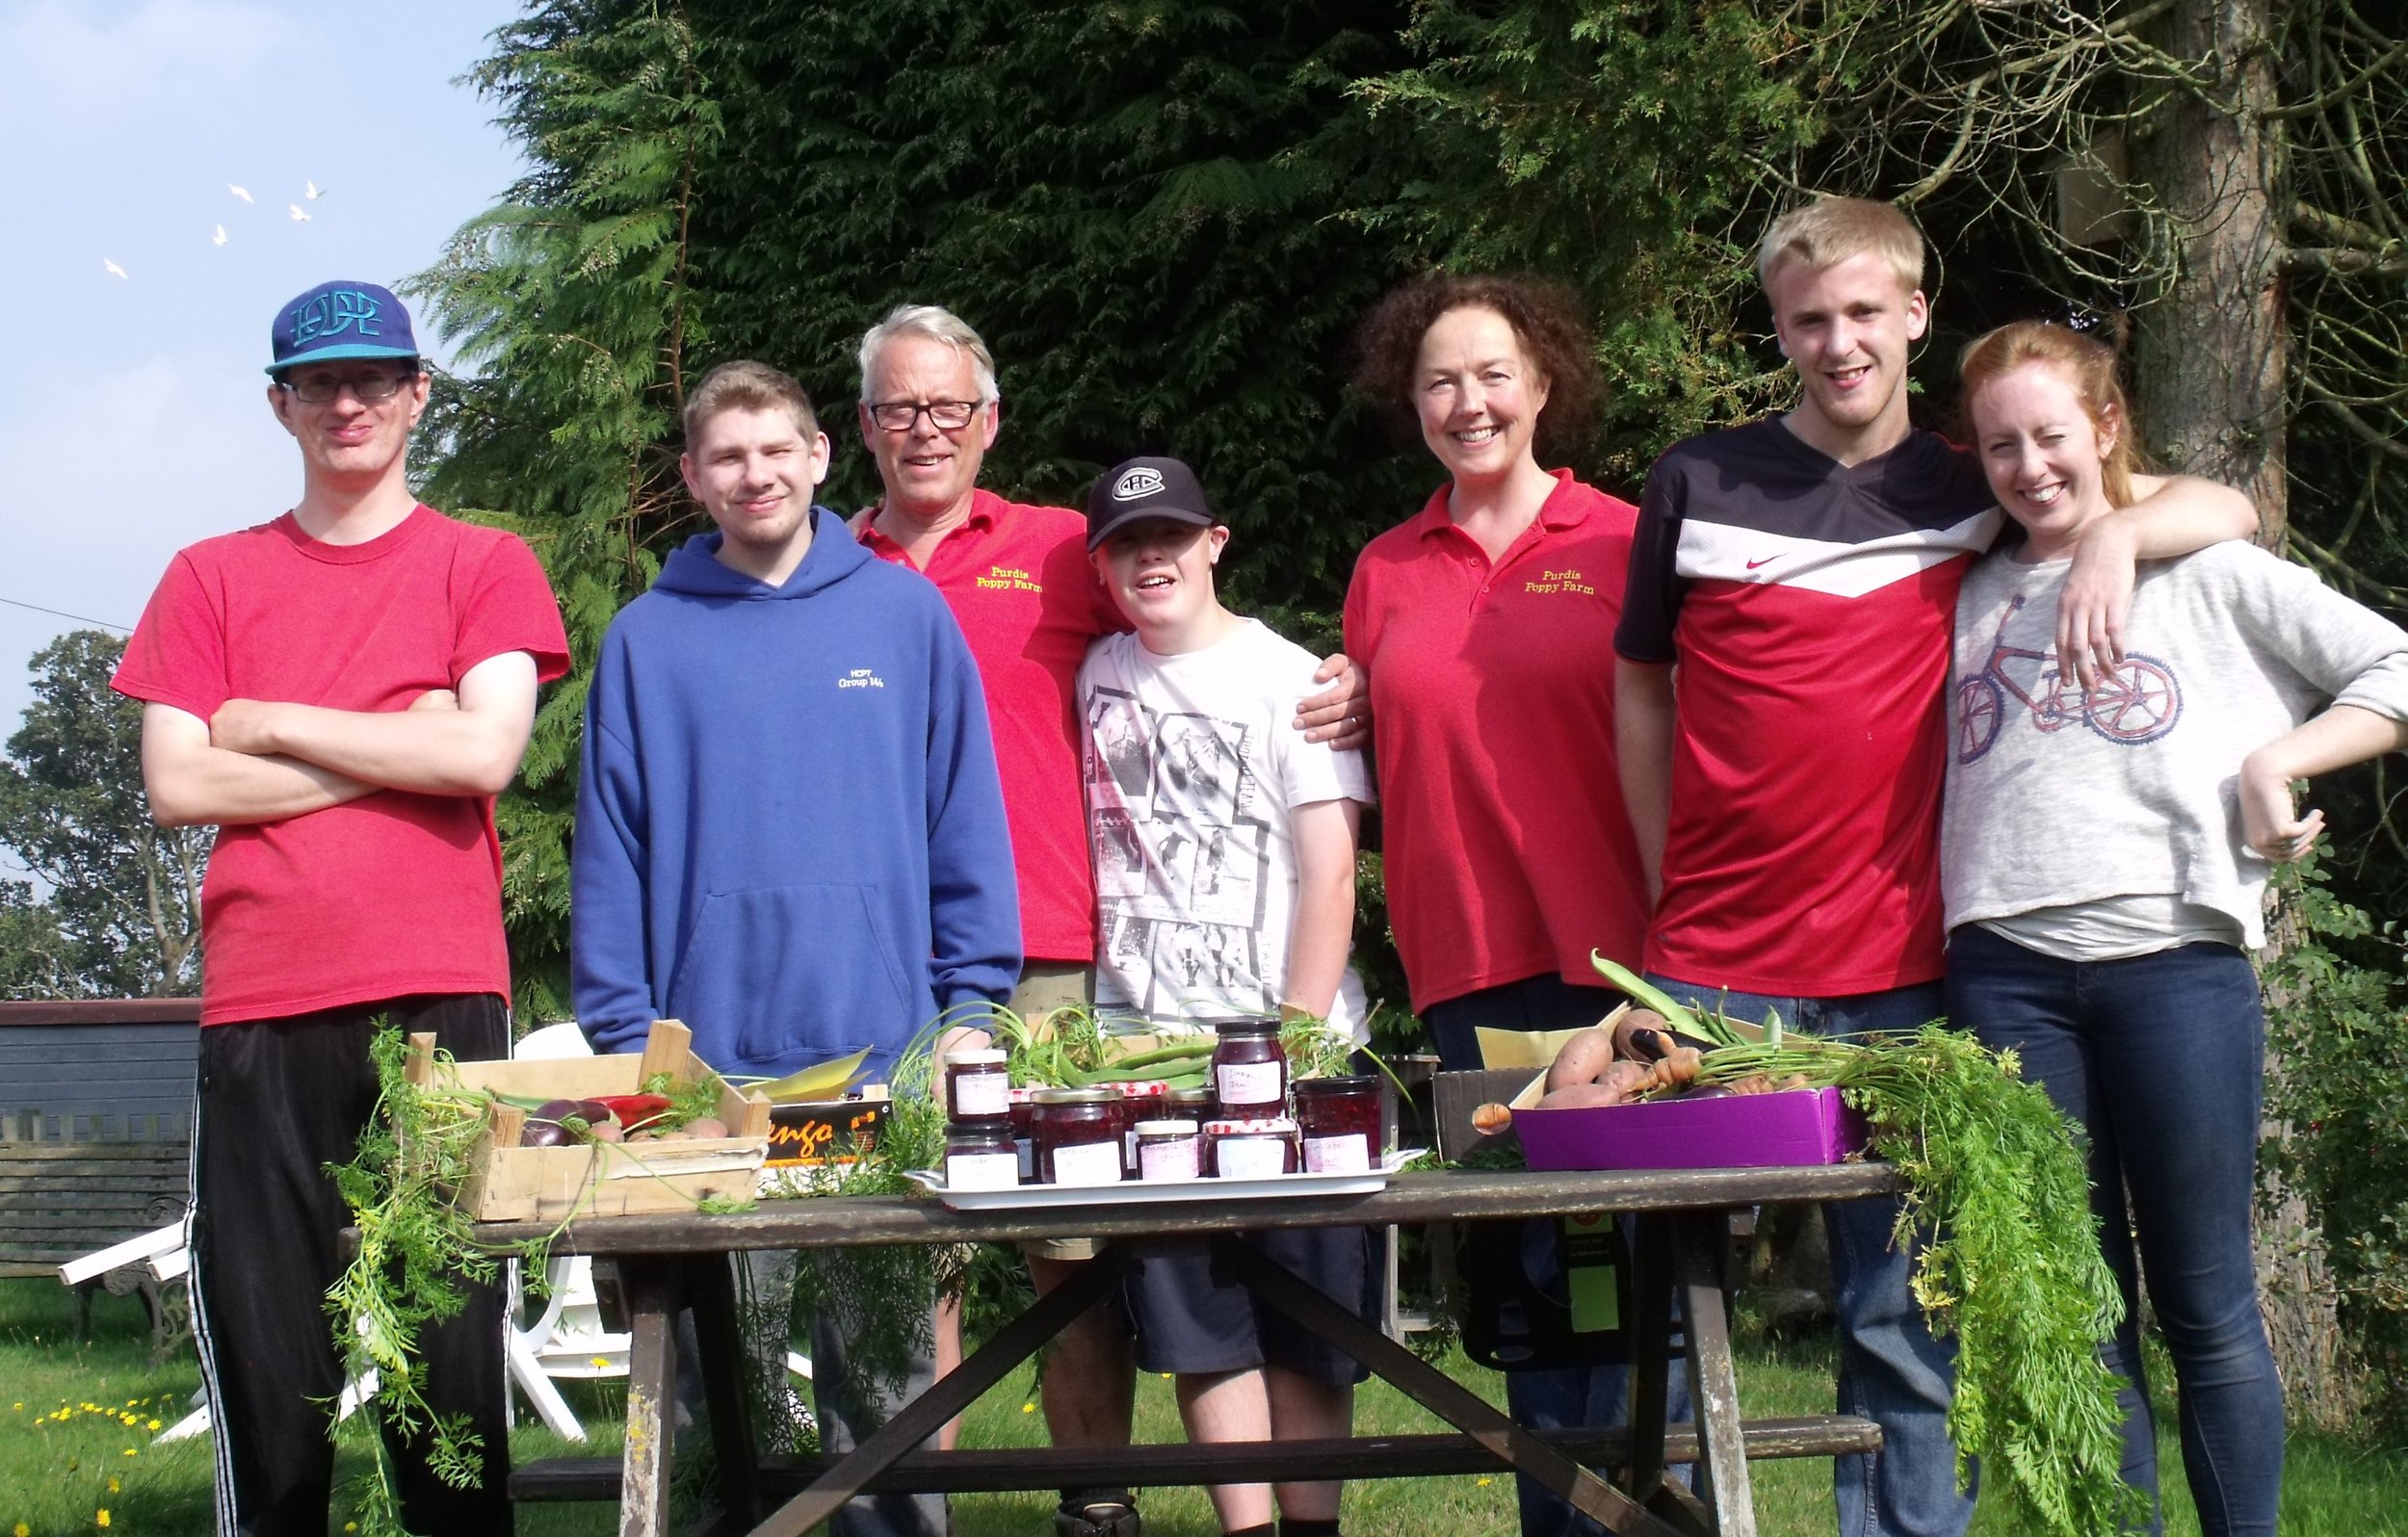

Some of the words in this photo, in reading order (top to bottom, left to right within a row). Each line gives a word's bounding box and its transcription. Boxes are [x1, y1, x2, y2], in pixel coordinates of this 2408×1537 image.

[991, 566, 1029, 579] Purdis
[1542, 570, 1582, 581] Purdis
[977, 577, 1011, 589] Poppy
[1014, 579, 1043, 592] Farm
[1525, 582, 1559, 593] Poppy
[1562, 581, 1594, 594] Farm
[838, 678, 868, 688] Group
